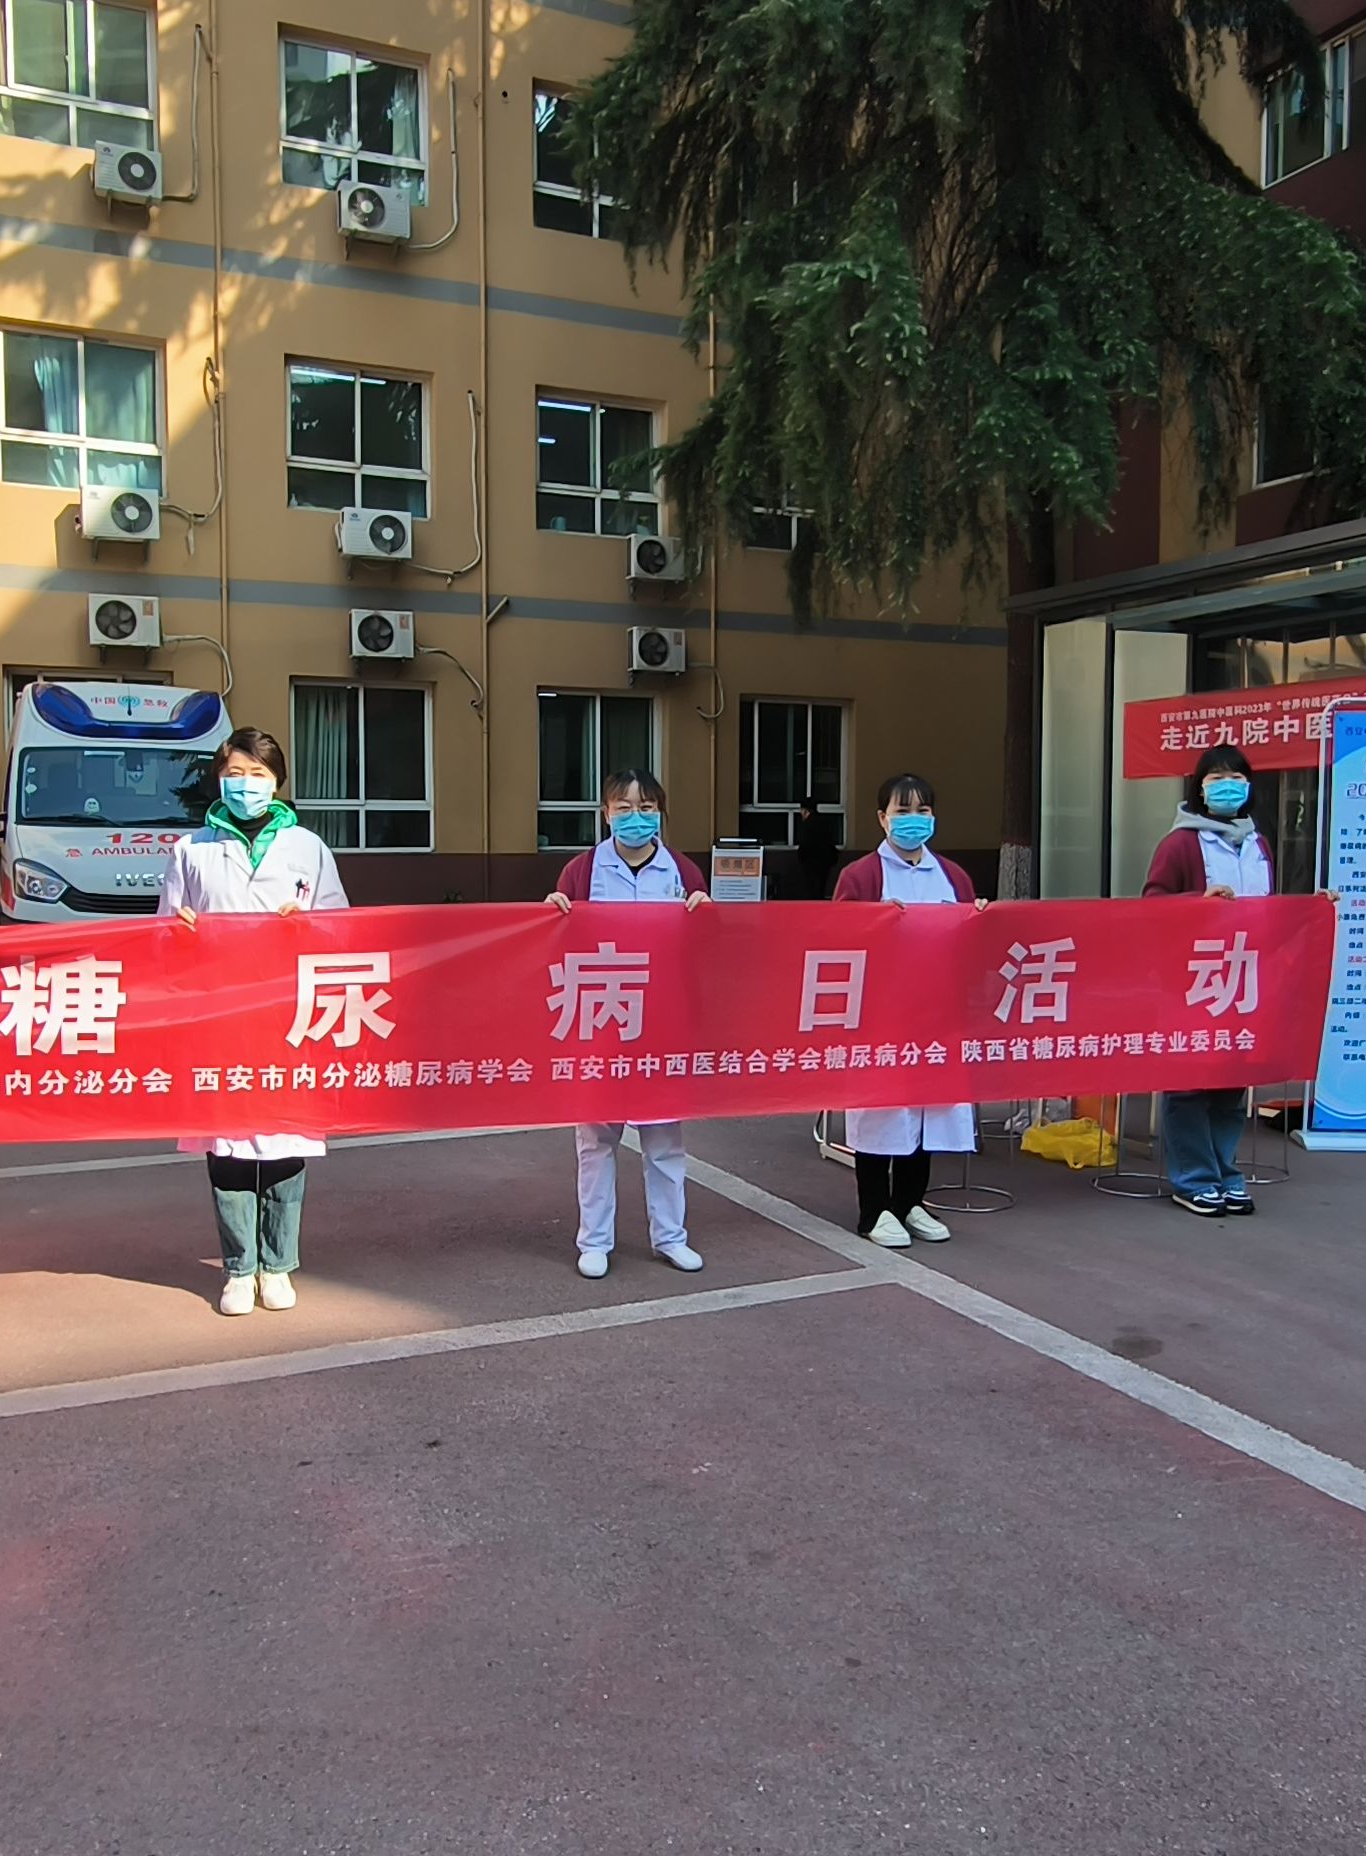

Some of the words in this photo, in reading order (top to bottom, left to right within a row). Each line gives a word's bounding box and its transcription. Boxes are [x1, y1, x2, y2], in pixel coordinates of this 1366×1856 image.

[106, 833, 181, 844] 120
[192, 1058, 534, 1093] 西安市内分泌糖尿病学会
[551, 1041, 947, 1081] 西安市中西医结合学会糖尿病分会
[961, 1029, 1256, 1063] 陕西省糖尿病护理专业委员会
